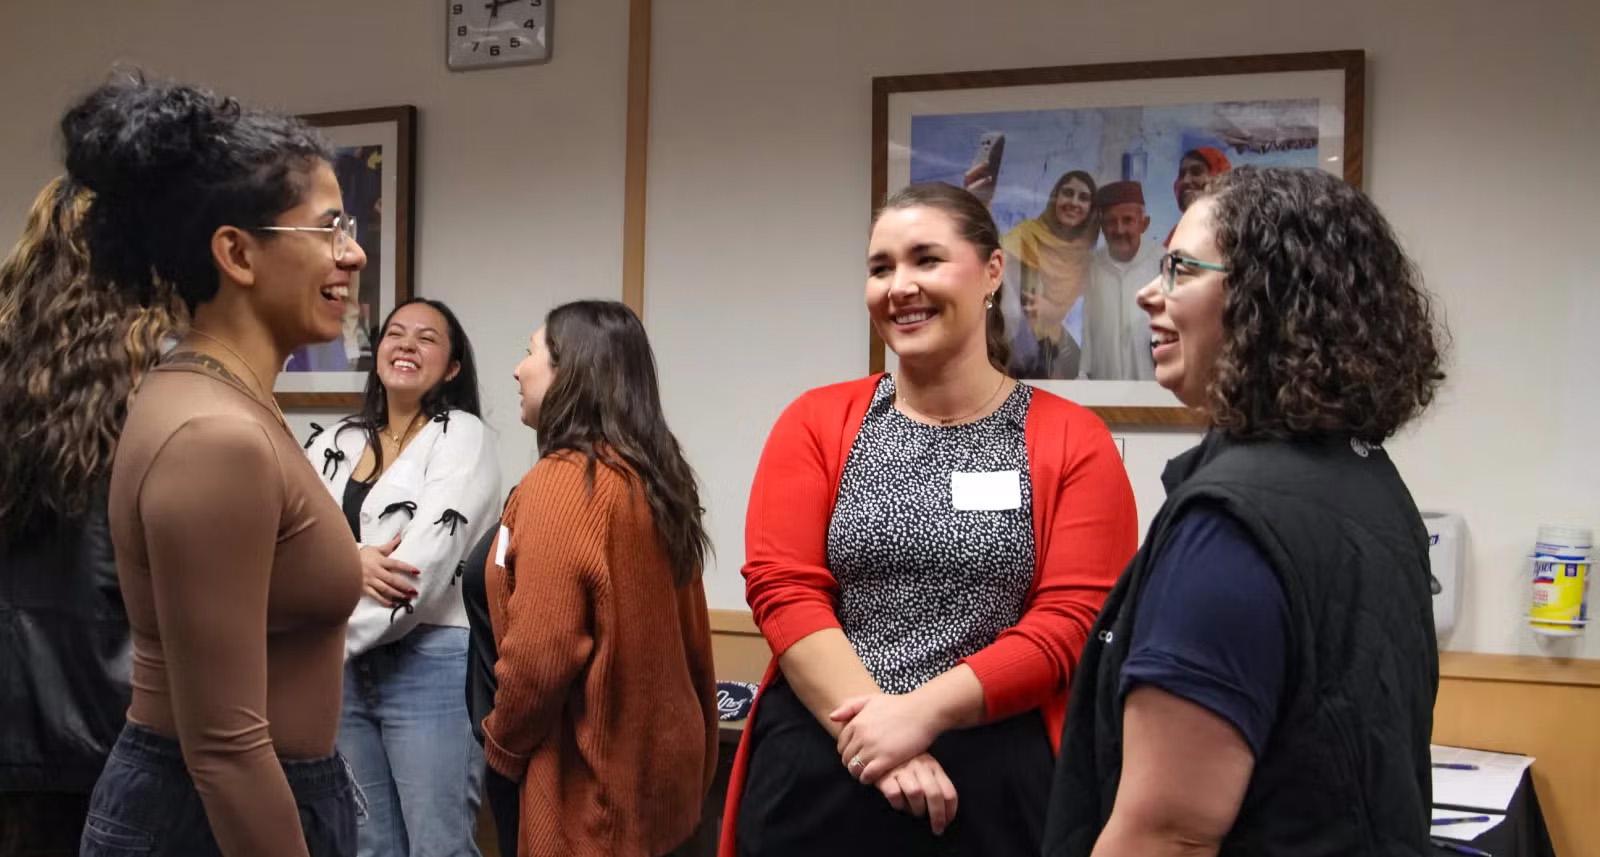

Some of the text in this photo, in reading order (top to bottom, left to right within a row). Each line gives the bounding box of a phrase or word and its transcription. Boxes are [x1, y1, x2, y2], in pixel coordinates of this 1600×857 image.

[453, 4, 463, 15] 9
[523, 19, 535, 30] 4
[457, 25, 467, 36] 8
[472, 42, 480, 52] 7
[510, 37, 521, 48] 5
[489, 45, 500, 56] 6
